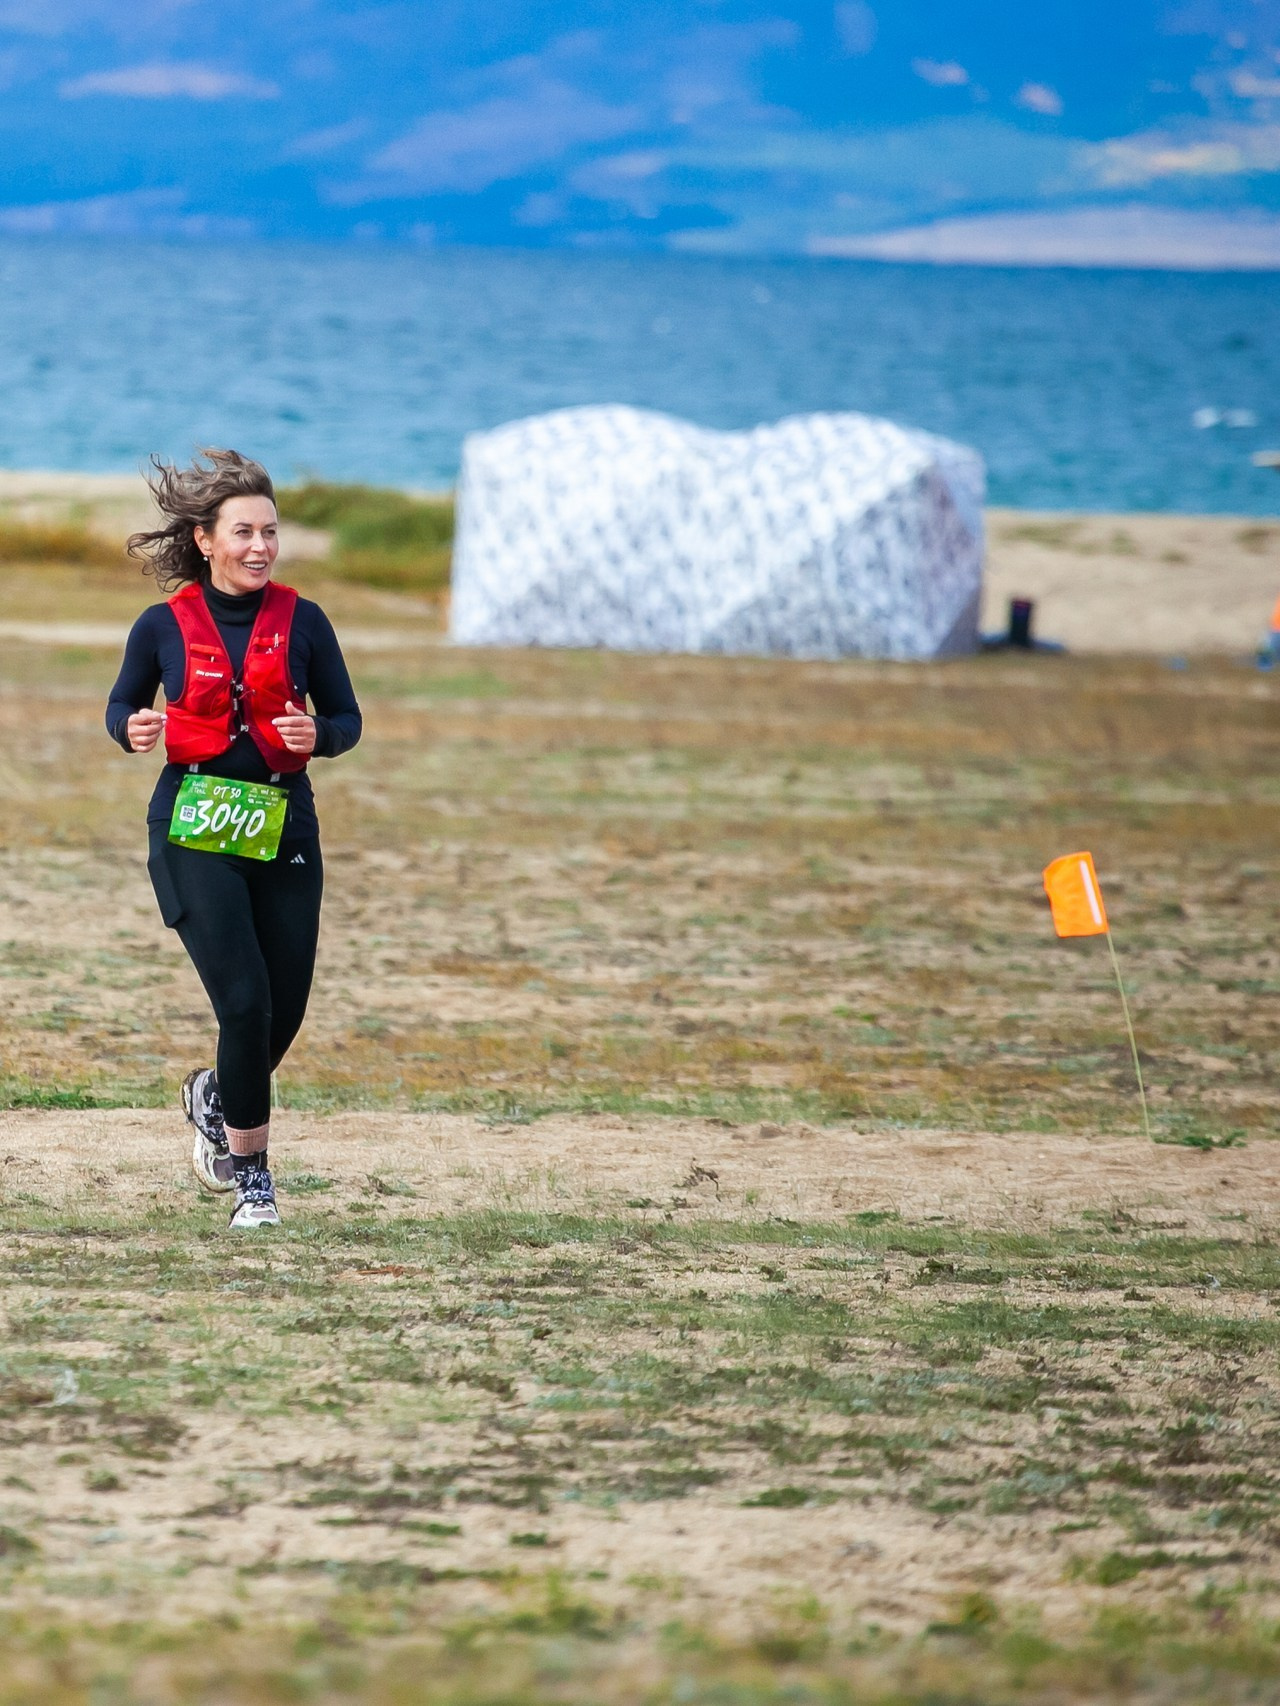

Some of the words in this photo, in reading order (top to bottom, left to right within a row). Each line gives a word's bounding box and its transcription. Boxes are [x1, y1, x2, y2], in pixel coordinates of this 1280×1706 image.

[213, 785, 231, 799] OT
[229, 787, 242, 799] 30
[192, 799, 266, 842] 3040
